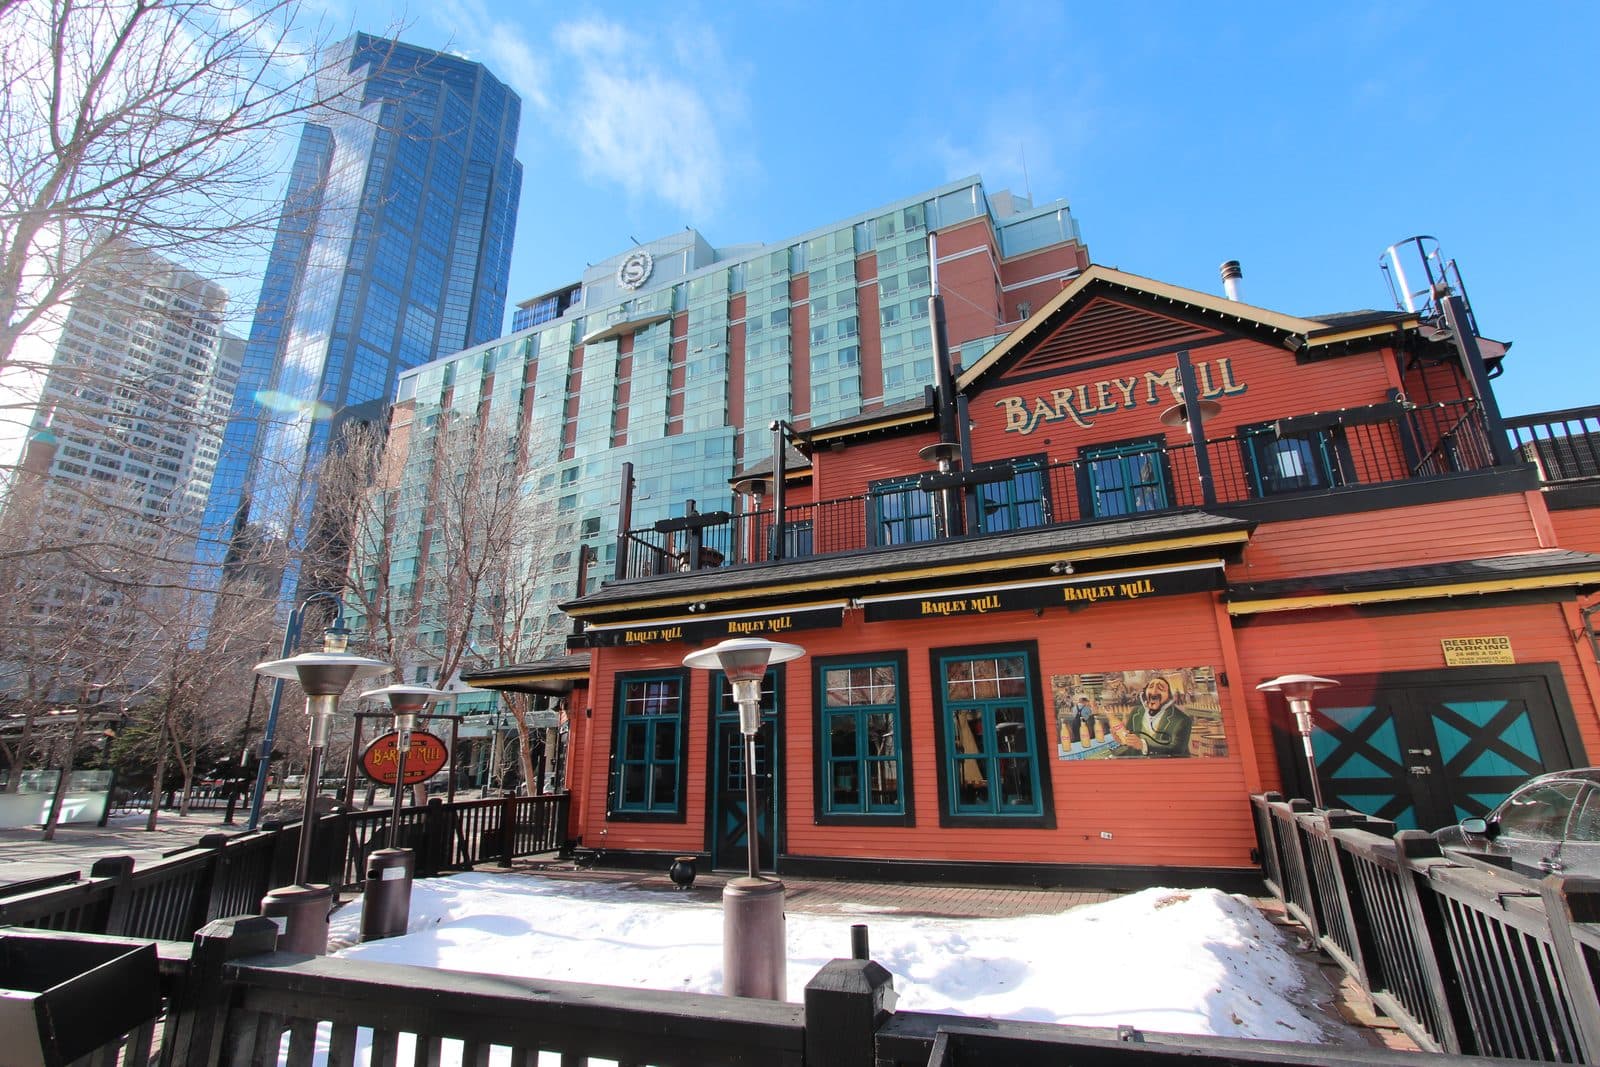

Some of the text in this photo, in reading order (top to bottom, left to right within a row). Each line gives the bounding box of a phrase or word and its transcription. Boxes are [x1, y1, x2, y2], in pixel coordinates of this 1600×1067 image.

[995, 357, 1248, 435] BARLEY MLL
[1064, 578, 1155, 602] BARLEY MILL
[921, 595, 1001, 616] BARLEY MILL
[728, 616, 792, 634] BARLEY MILL
[625, 627, 682, 643] BARLEY MILL
[1443, 637, 1508, 647] RESERVED
[1445, 644, 1510, 652] PARKING
[373, 748, 413, 768] BAR
